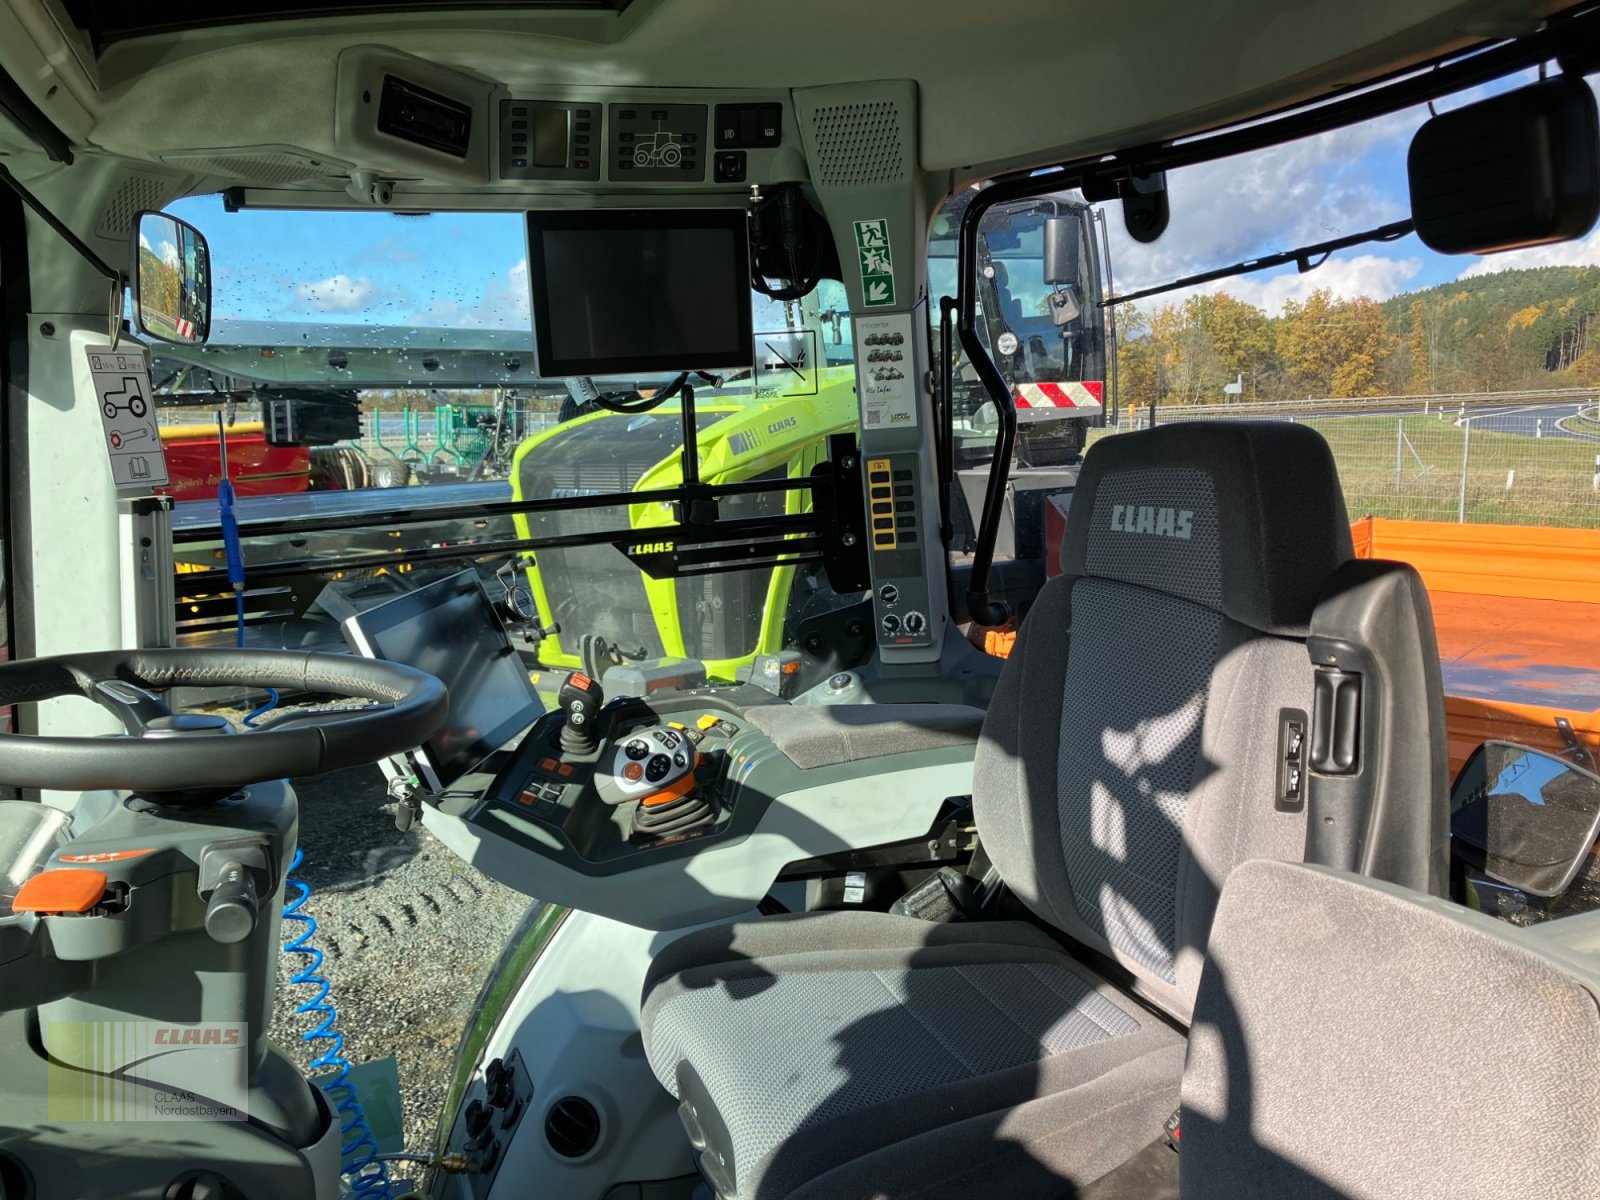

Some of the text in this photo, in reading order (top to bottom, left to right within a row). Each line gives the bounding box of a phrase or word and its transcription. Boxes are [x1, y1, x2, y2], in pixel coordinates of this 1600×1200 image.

[767, 416, 797, 435] CLAAS
[1110, 504, 1194, 540] CLAAS
[627, 541, 674, 556] CLAAS
